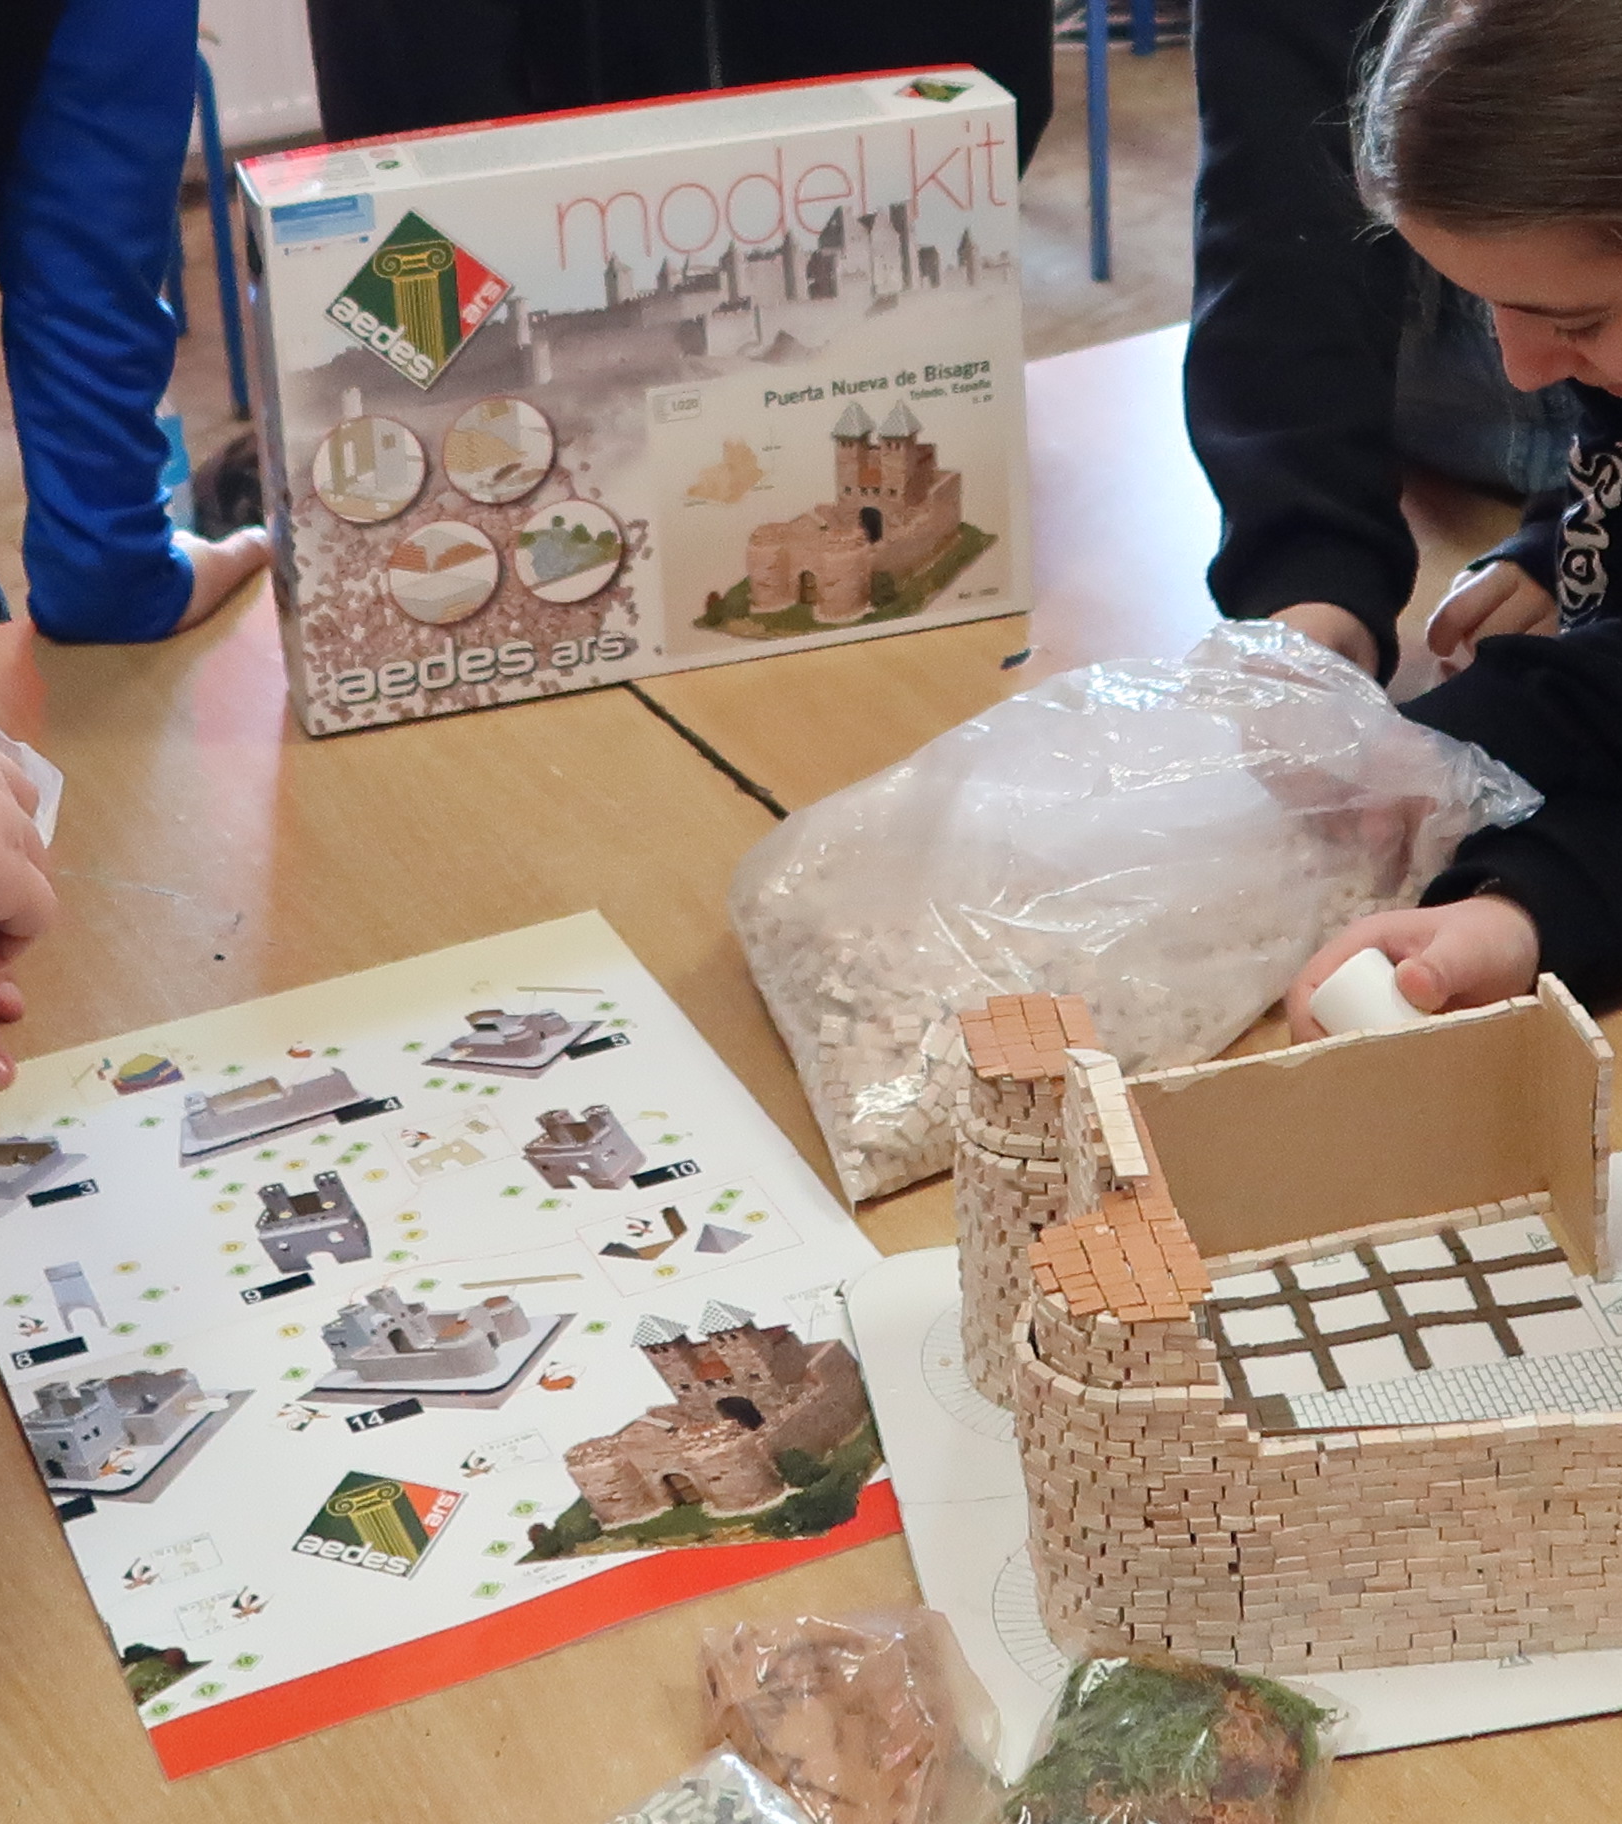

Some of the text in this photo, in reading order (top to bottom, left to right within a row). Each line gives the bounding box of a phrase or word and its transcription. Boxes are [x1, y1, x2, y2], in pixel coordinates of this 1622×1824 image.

[555, 120, 1007, 270] model kit
[331, 279, 504, 380] aedes ars
[764, 359, 991, 408] Puerta Nueva de Bisagra
[336, 631, 628, 704] aedes ars
[666, 1161, 697, 1178] 10
[352, 1411, 384, 1430] 14
[297, 1493, 457, 1575] aedes ars
